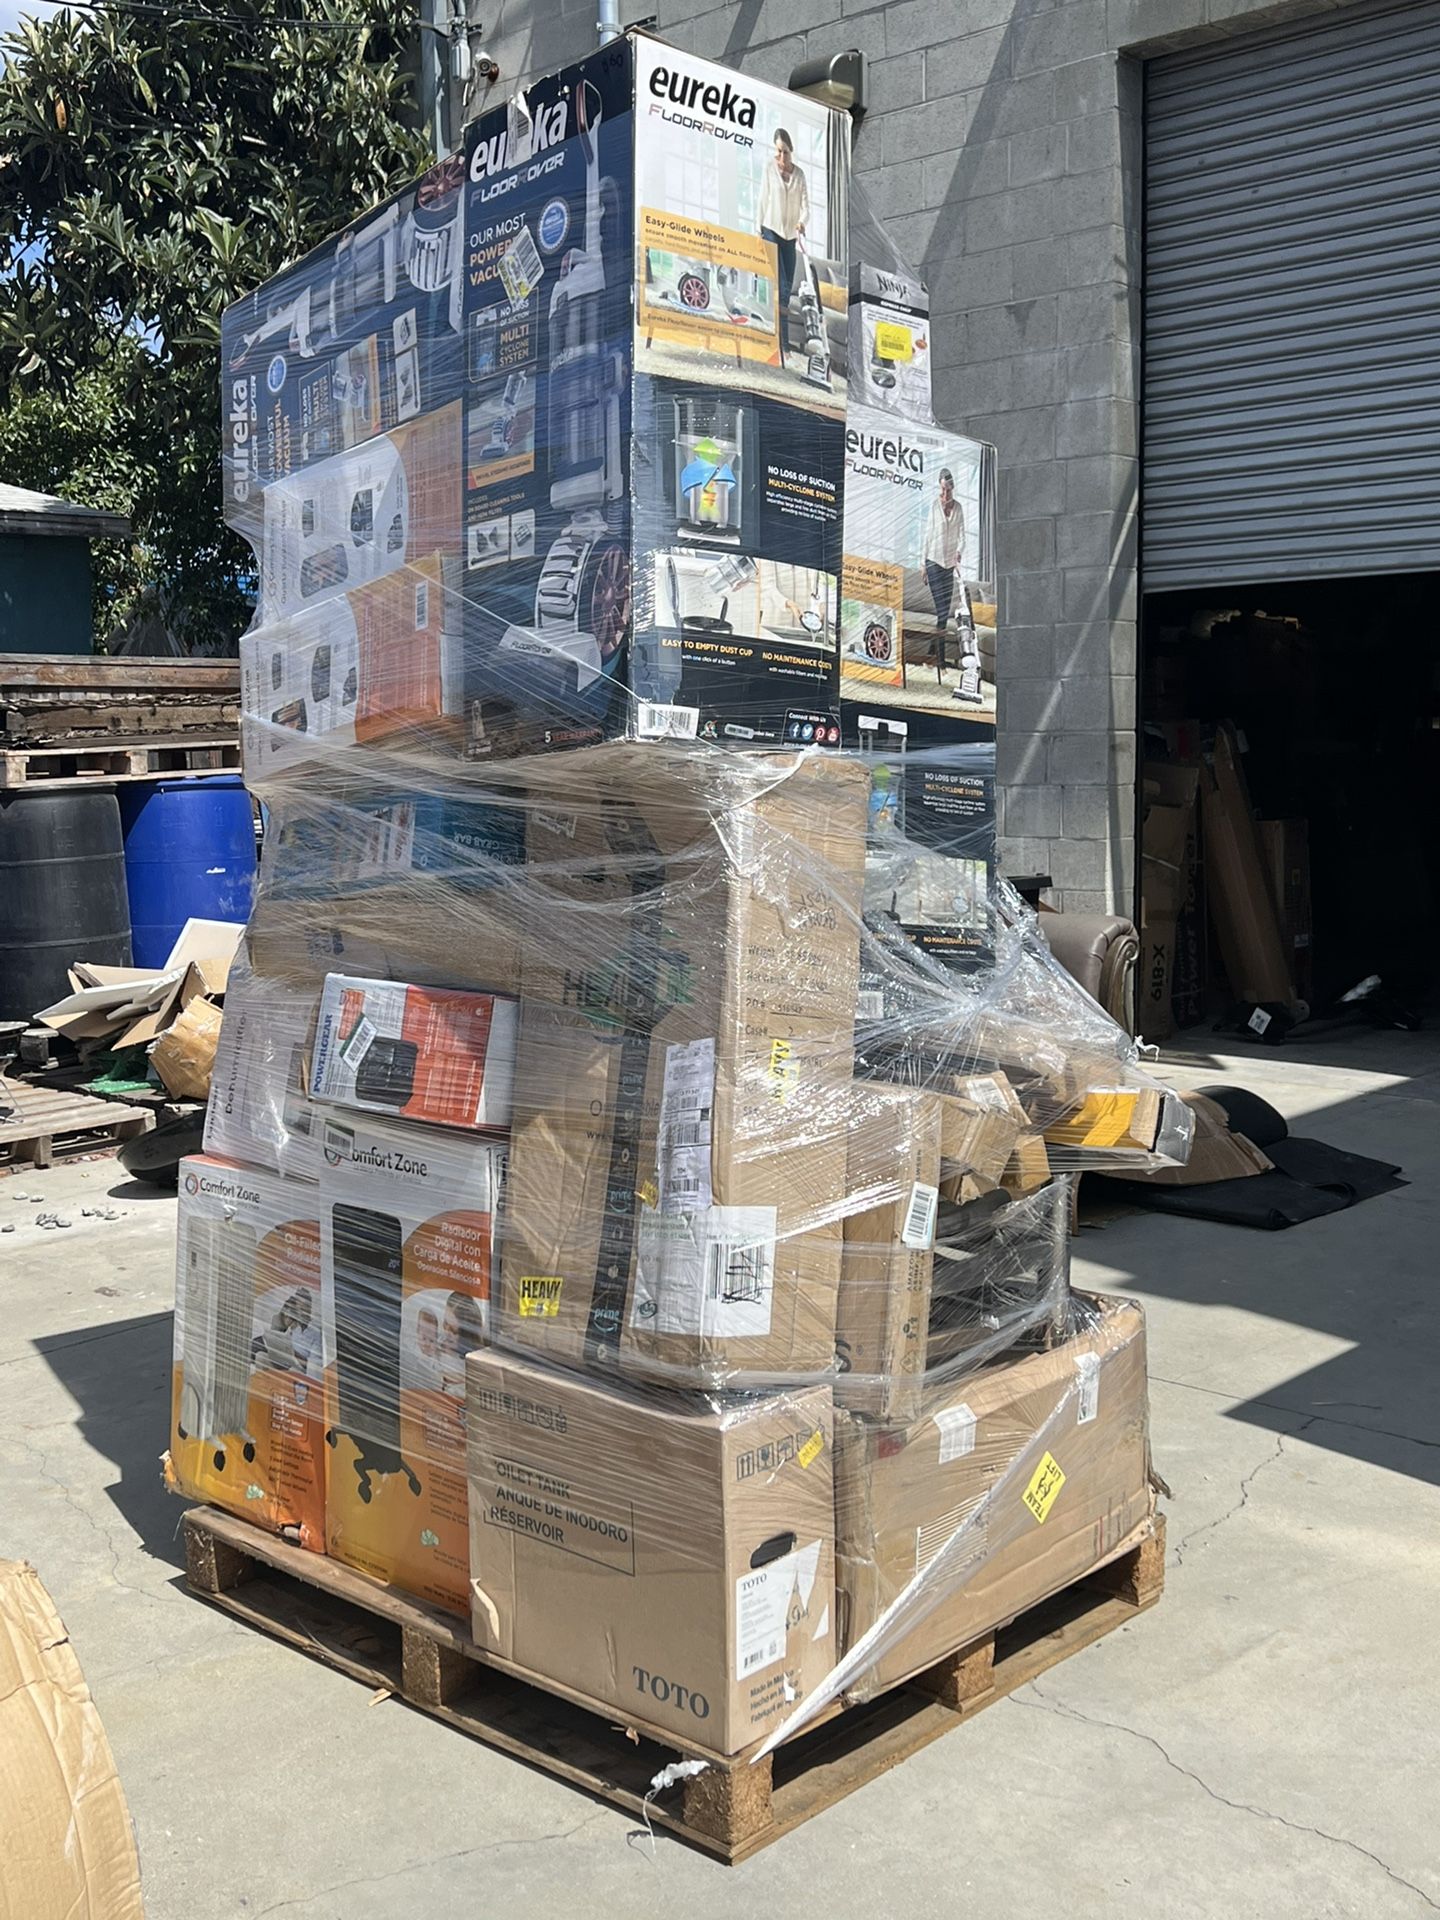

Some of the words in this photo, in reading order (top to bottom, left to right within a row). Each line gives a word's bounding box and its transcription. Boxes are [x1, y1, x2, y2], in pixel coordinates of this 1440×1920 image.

[649, 66, 756, 129] eureka
[470, 100, 568, 182] euka
[470, 227, 493, 248] OUR
[495, 212, 526, 238] MOST
[645, 215, 692, 235] Easy-Glide
[694, 227, 725, 243] Wheels
[500, 324, 529, 345] MULTI
[500, 348, 529, 367] SYSTEM
[230, 378, 249, 503] eureka
[846, 429, 924, 473] eureka
[768, 465, 779, 476] NO
[780, 468, 797, 481] LOSS
[798, 472, 807, 483] OF
[808, 475, 836, 491] SUCTION
[768, 478, 814, 497] MULTI-CYCLONE
[662, 638, 682, 648] EASY
[684, 640, 694, 649] TO
[695, 642, 719, 652] EMPTY
[720, 644, 738, 655] DUST
[739, 646, 753, 656] CUP
[762, 652, 773, 661] NO
[773, 653, 817, 668] MAINTENANCE
[545, 730, 552, 744] 5
[925, 772, 934, 780] NO
[935, 774, 949, 782] LOSS
[959, 777, 984, 787] SUCTION
[925, 784, 964, 794] MULTI-CYCLONE
[454, 831, 472, 845] BAR
[474, 835, 499, 849] GRAB
[932, 936, 966, 945] MAINTENANCE
[1151, 944, 1165, 1001] X-819
[313, 1014, 333, 1094] POWERGEAR
[352, 1147, 392, 1169] omfort
[394, 1154, 427, 1177] Zone
[200, 1177, 235, 1198] Comfort
[237, 1185, 260, 1203] Zone
[441, 1222, 481, 1241] Radiador
[435, 1235, 462, 1252] Digital
[464, 1245, 481, 1257] con
[413, 1245, 438, 1262] Carga
[440, 1252, 450, 1263] de
[452, 1256, 480, 1271] Aceite
[907, 1251, 915, 1292] AMAZON
[521, 1280, 561, 1299] HEAVY
[594, 1308, 621, 1321] prime
[494, 1461, 532, 1486] OILET
[538, 1474, 571, 1499] TANK
[1046, 1460, 1062, 1482] LIFT
[496, 1484, 541, 1512] ANQUE
[545, 1503, 562, 1519] DE
[566, 1509, 628, 1543] INODORO
[1026, 1491, 1044, 1519] TEAM
[490, 1504, 565, 1544] RÉSERVOIR
[742, 1573, 767, 1592] TOTO
[632, 1665, 710, 1719] TOTO
[750, 1683, 766, 1698] Made
[767, 1680, 773, 1688] in
[750, 1695, 770, 1711] Hecho
[770, 1691, 778, 1701] en
